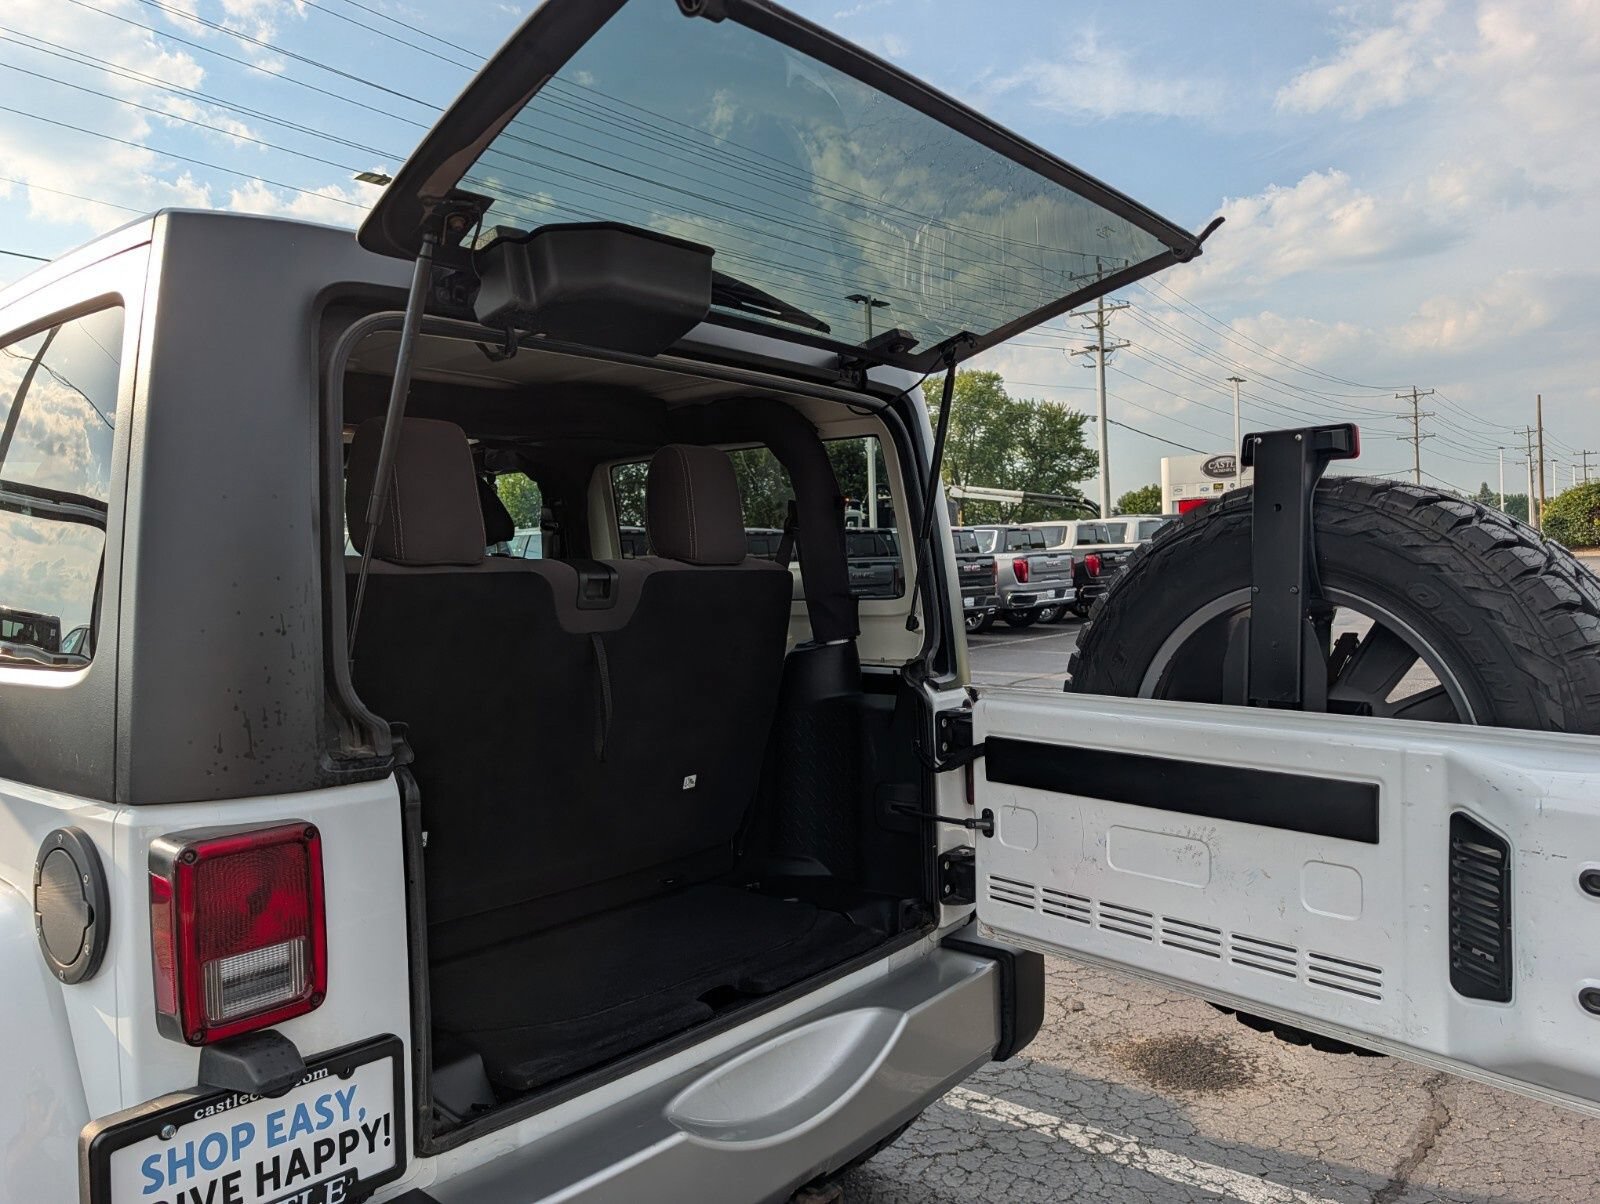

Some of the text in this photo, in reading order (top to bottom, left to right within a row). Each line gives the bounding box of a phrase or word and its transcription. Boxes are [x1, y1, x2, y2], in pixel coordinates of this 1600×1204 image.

[1208, 460, 1236, 470] CASTL
[141, 1084, 367, 1195] SHOP EASY,
[256, 1113, 391, 1198] HAPPY!
